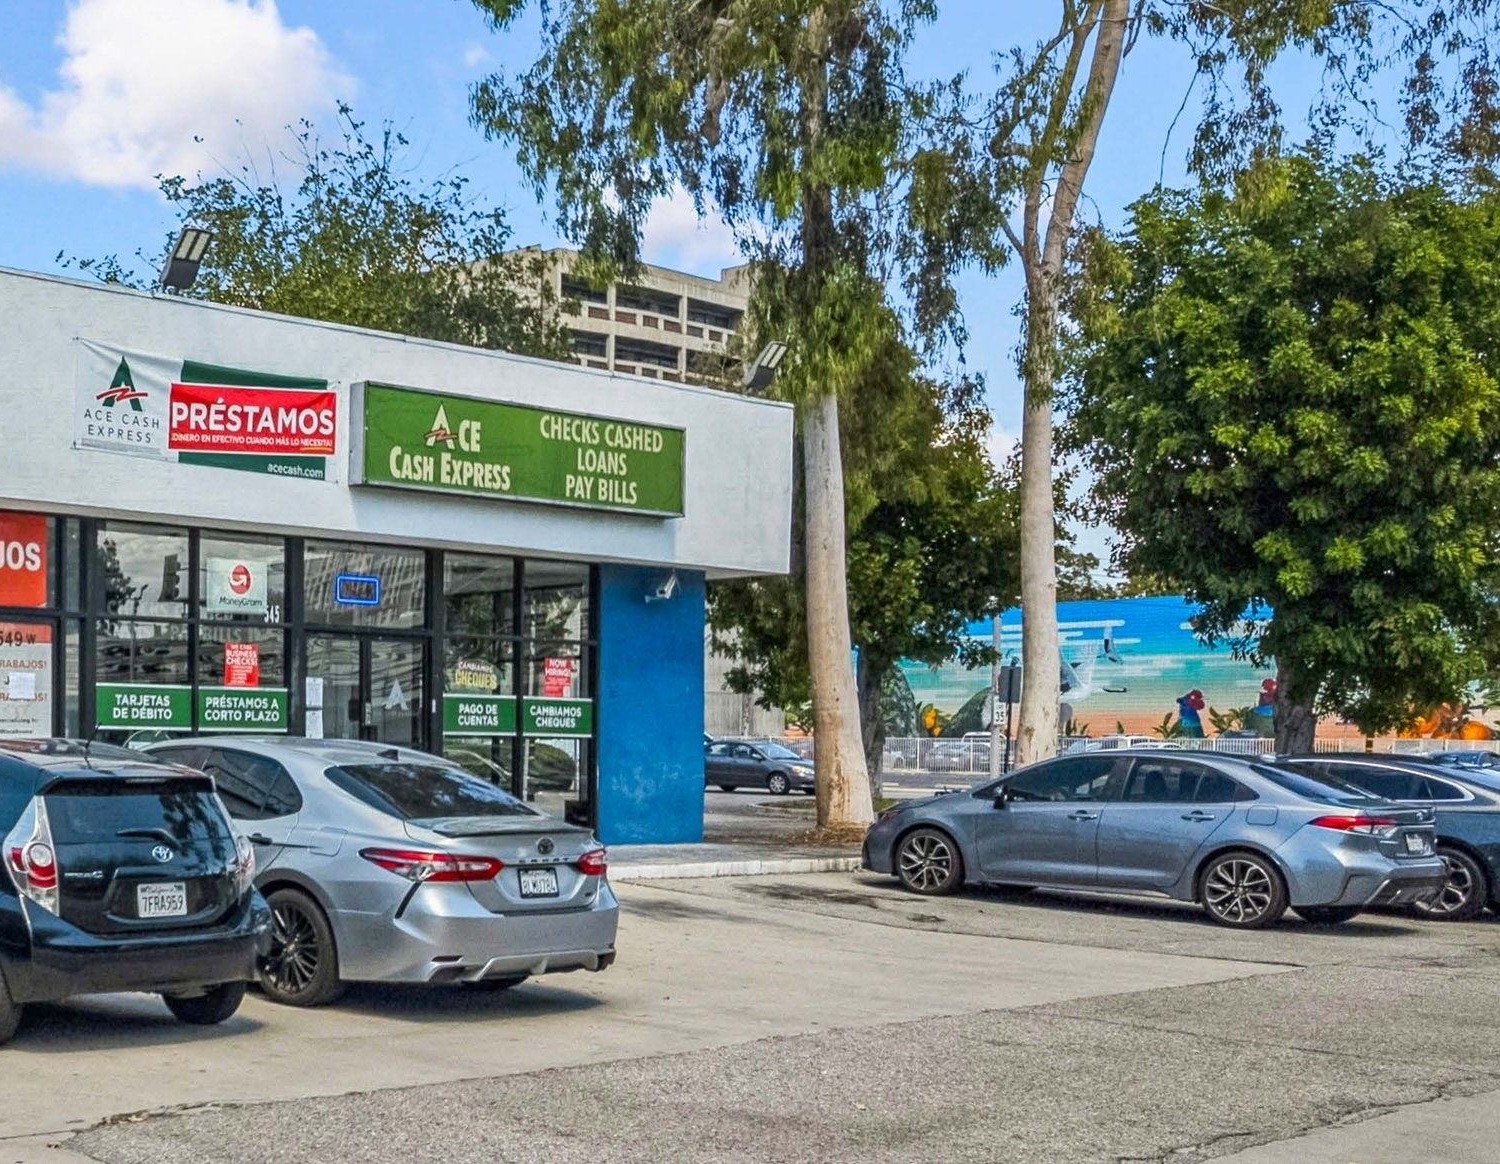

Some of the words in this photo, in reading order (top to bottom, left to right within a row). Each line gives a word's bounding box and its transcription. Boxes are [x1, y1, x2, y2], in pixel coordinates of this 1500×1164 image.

[84, 408, 113, 422] ACE
[122, 413, 160, 429] CASH
[172, 397, 334, 435] PRÉSTAMOS
[88, 424, 151, 443] EXPRESS
[201, 434, 211, 443] EN
[212, 434, 245, 444] EFECTIVO
[245, 437, 274, 446] CUANDO
[275, 436, 290, 446] MÁS
[290, 438, 300, 446] LO
[539, 416, 600, 444] CHECKS
[604, 424, 663, 453] CASHED
[577, 448, 627, 476] LOANS
[267, 463, 324, 478] acecash.com
[566, 475, 593, 500] PAY
[598, 479, 637, 504] BILLS
[219, 596, 263, 607] MoneyGram
[264, 605, 280, 623] 545
[26, 633, 36, 645] W
[226, 650, 257, 658] BUSINESS
[458, 661, 493, 673] CAMBIAMOS
[549, 659, 567, 668] NOW
[455, 670, 497, 690] CHEQUES
[115, 694, 170, 706] TARJETAS
[206, 695, 268, 709] PRÉSTAMOS
[271, 698, 279, 709] A
[112, 708, 128, 719] DE
[131, 706, 173, 720] DÉBITO
[205, 709, 242, 721] CORTO
[245, 710, 280, 722] PLAZO
[459, 704, 484, 714] PAGO
[486, 705, 497, 714] DE
[530, 706, 581, 717] CAMBIAMOS
[458, 716, 498, 726] CUENTAS
[536, 717, 576, 728] CHEQUES
[996, 711, 1004, 722] 35
[142, 895, 184, 913] 7FRA959
